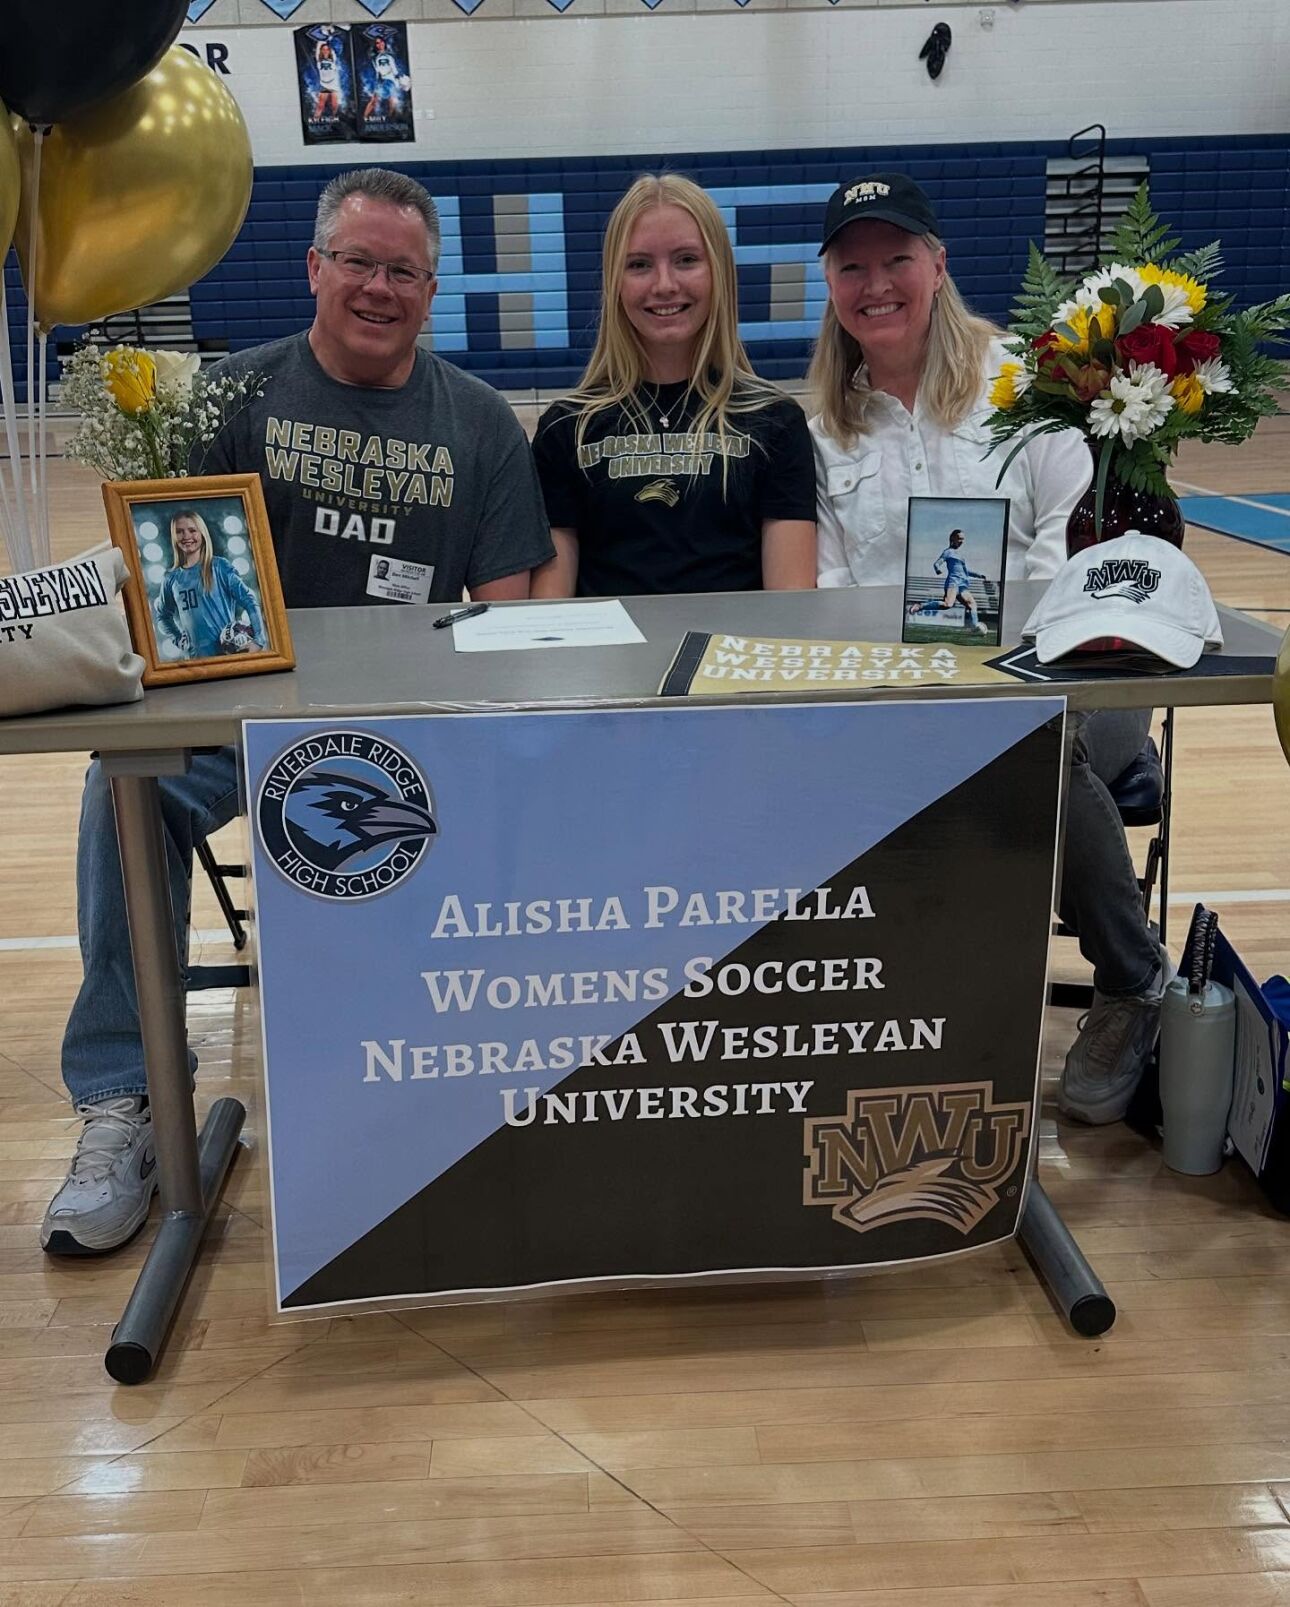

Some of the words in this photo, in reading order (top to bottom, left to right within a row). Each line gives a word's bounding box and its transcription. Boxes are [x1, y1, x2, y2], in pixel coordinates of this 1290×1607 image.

[266, 416, 454, 475] NEBRASKA
[265, 446, 454, 508] WESLEYAN
[608, 453, 714, 479] UNIVERSITY
[302, 488, 414, 517] UNIVERSITY
[314, 506, 396, 545] DAD
[402, 563, 427, 573] VISITOR
[1083, 559, 1161, 593] NWU
[179, 588, 199, 611] 30
[714, 650, 958, 668] WESLEYAN
[720, 635, 958, 658] NEBRASKA
[702, 665, 961, 681] UNIVERSITY
[265, 736, 363, 801] RIVERDALE
[367, 743, 423, 798] RIDGE
[277, 850, 329, 893] HIGH
[335, 847, 418, 896] SCHOOL
[811, 1087, 1026, 1198] NWU
